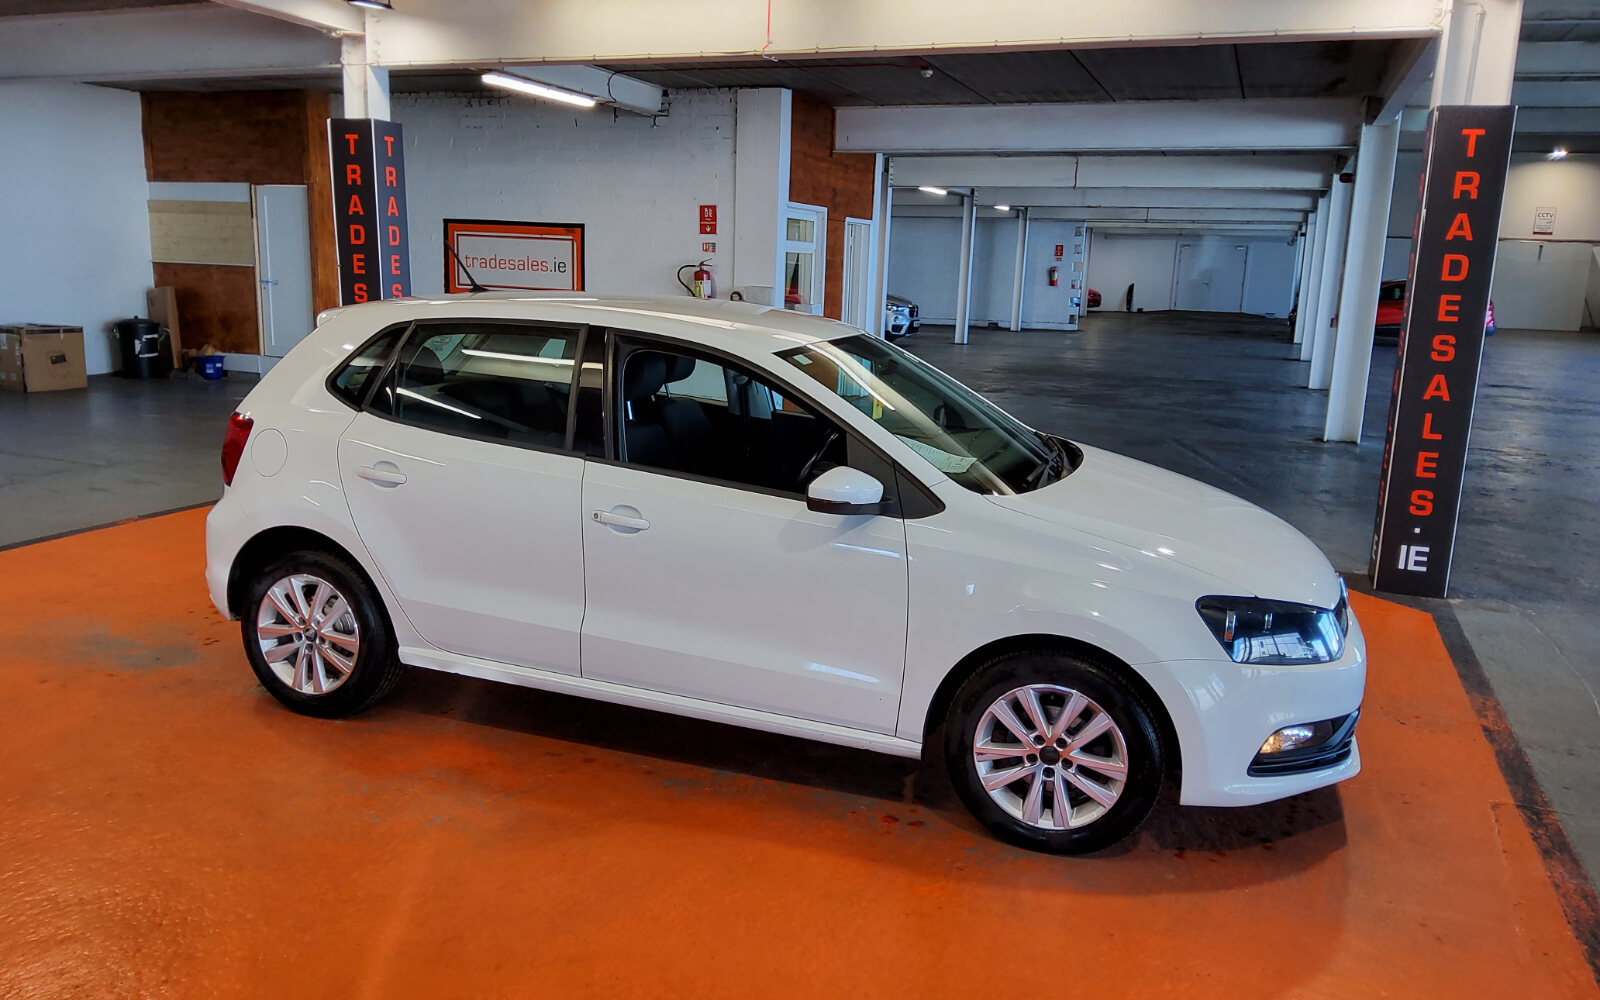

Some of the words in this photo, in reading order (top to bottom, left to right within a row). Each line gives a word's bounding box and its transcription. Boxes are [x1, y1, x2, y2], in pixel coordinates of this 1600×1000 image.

[344, 133, 368, 303] TRADES
[383, 136, 403, 299] TRADES
[464, 253, 567, 274] tradesales.ie
